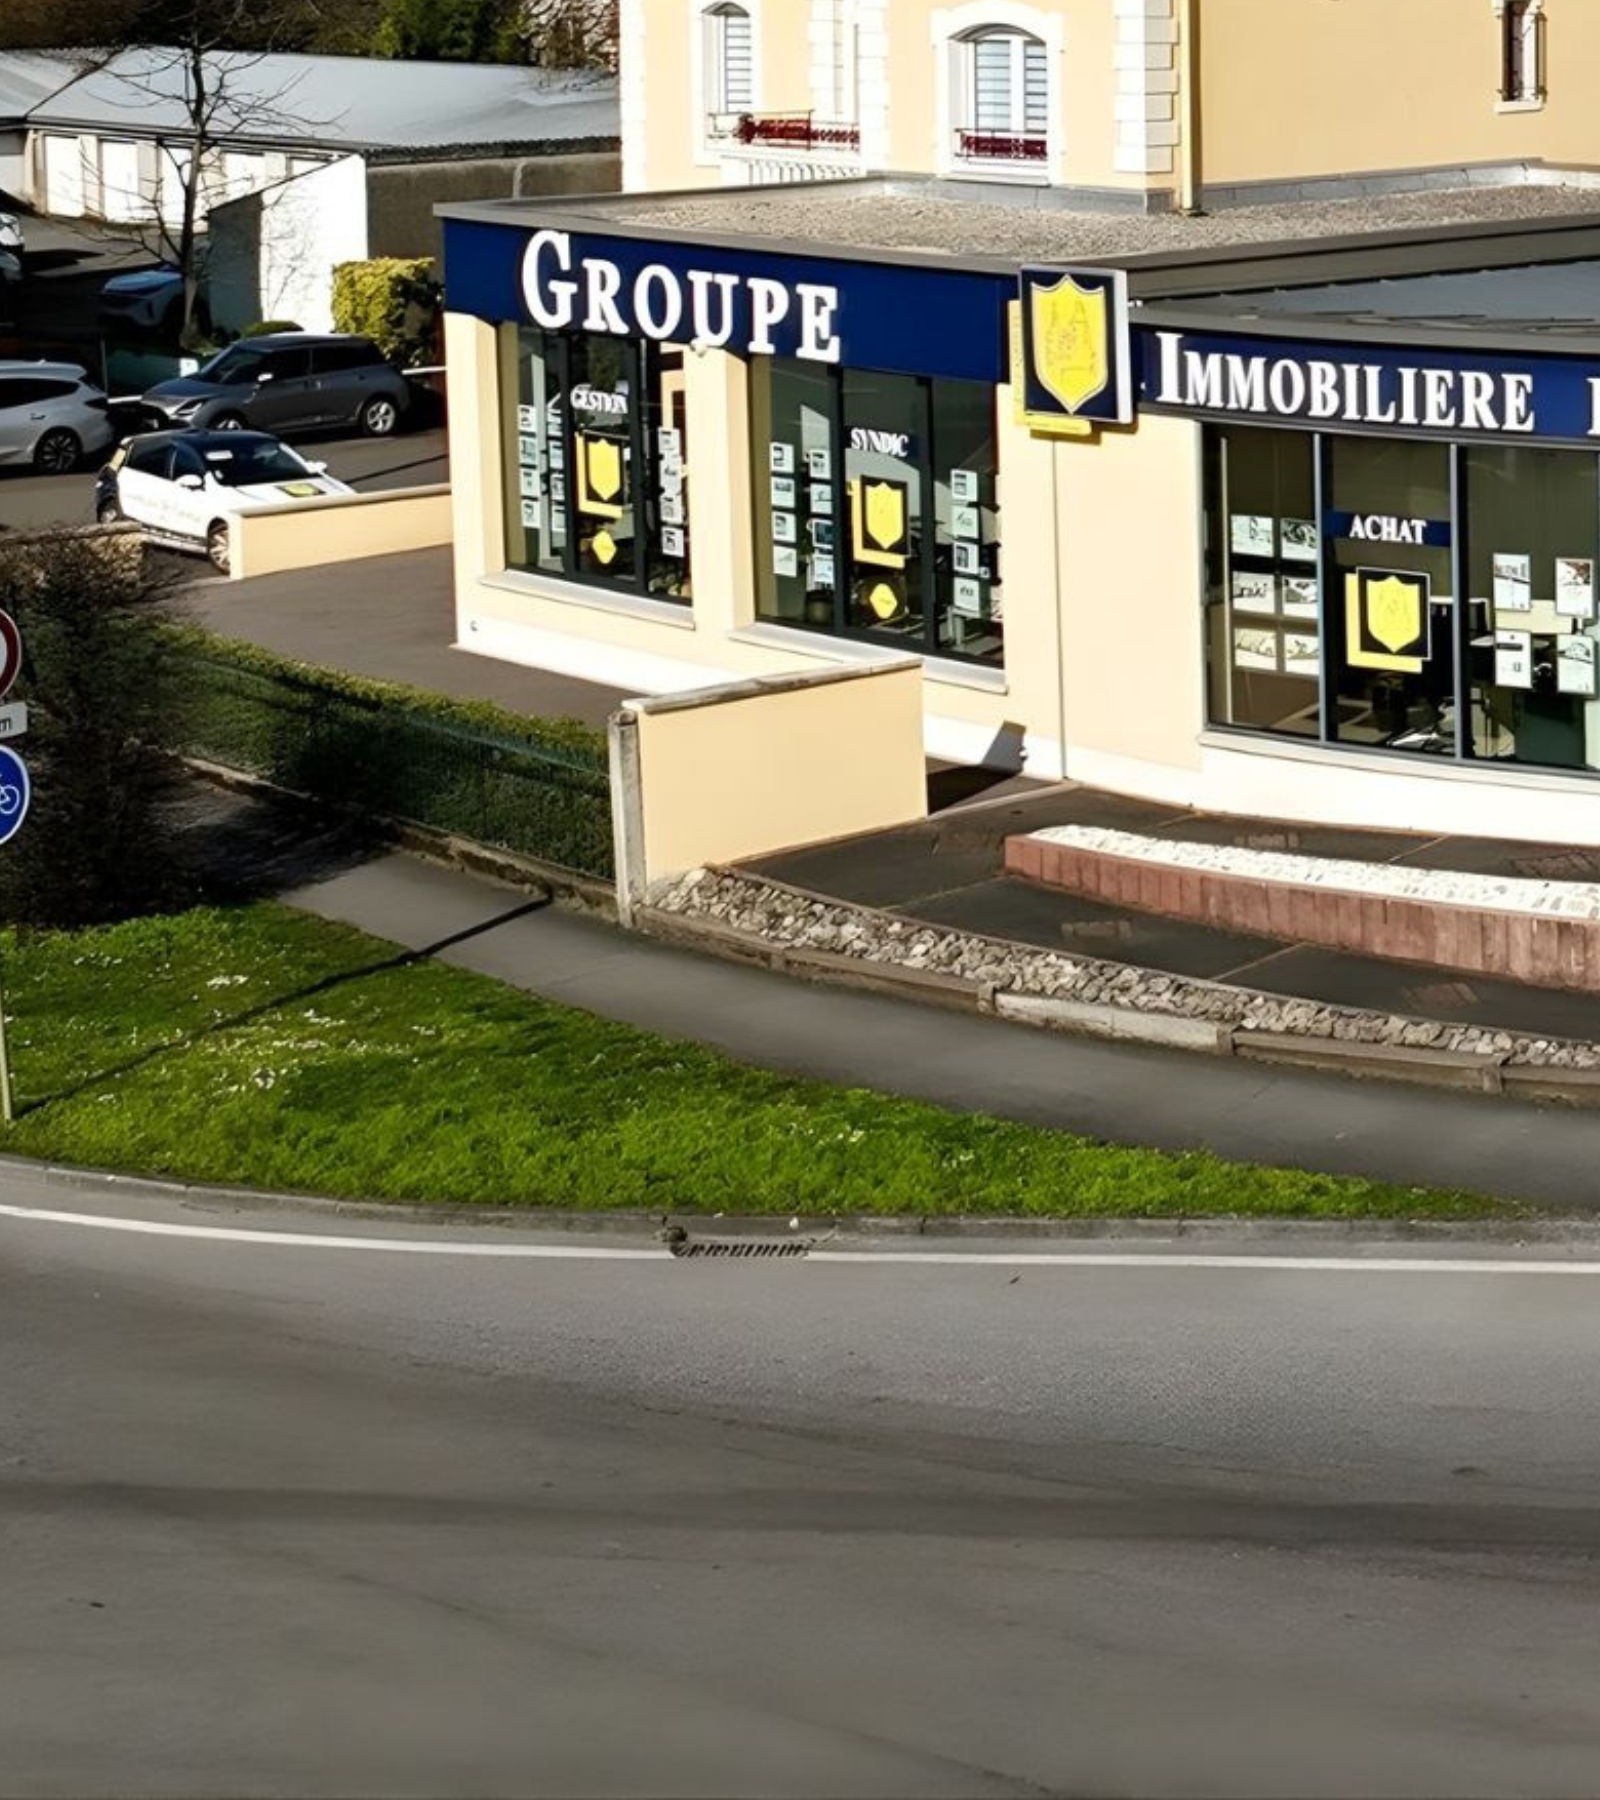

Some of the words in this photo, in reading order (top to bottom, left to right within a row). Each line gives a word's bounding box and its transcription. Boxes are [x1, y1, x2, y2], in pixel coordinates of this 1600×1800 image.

[521, 229, 841, 363] GROUPE
[1155, 332, 1534, 432] IMMOBILIERE
[850, 431, 909, 458] SYNDIC
[1349, 513, 1427, 546] ACHAT
